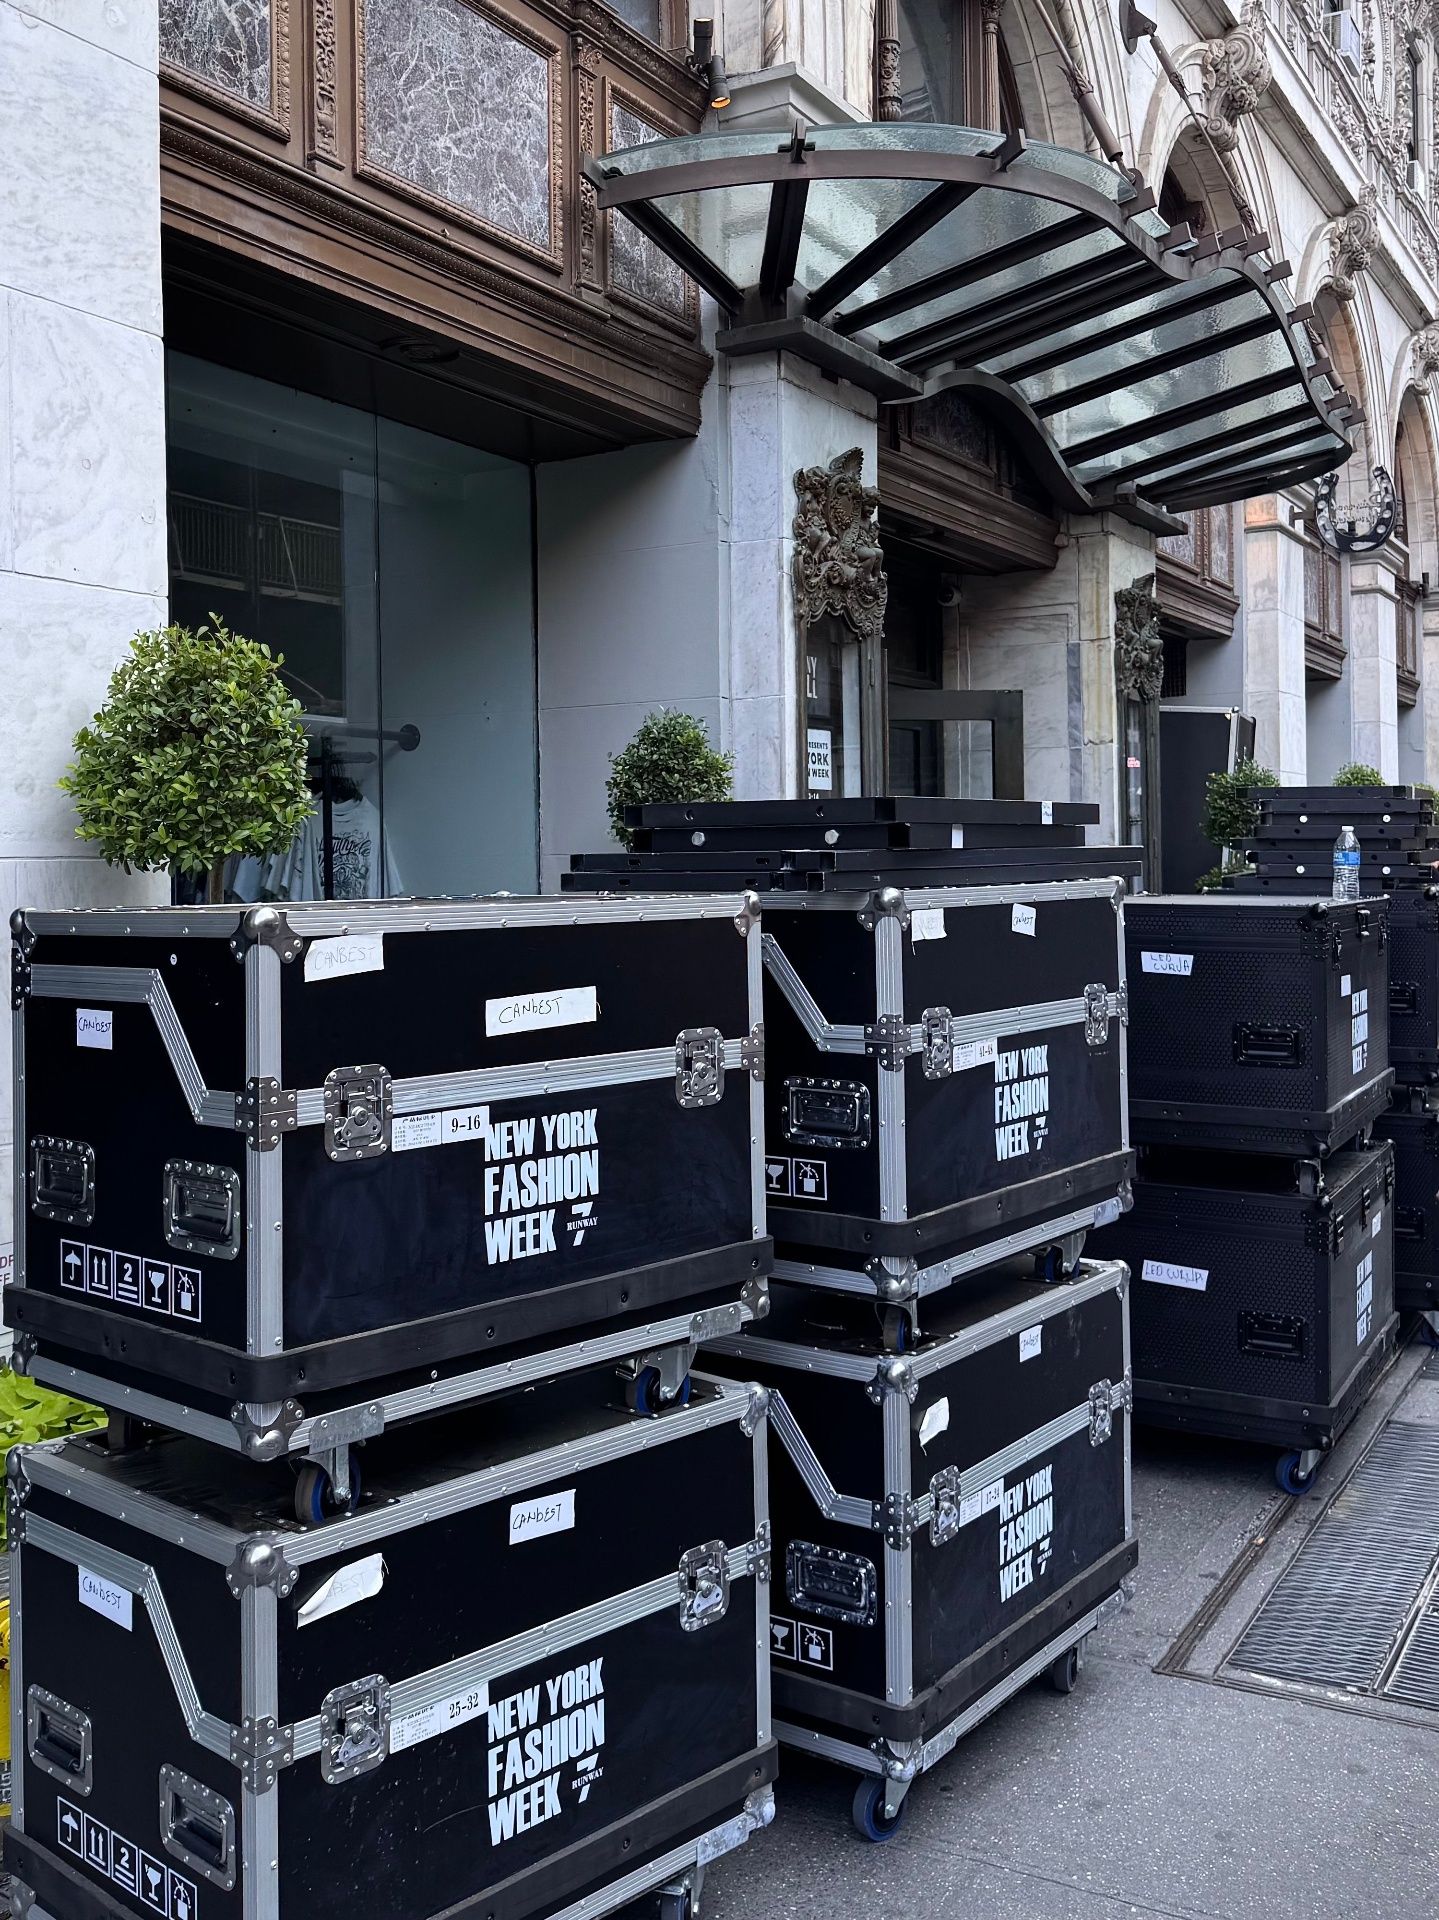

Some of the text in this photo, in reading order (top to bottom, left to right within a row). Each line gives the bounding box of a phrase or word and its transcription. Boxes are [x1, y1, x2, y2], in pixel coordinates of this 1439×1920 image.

[994, 1050, 1020, 1083] NEW
[1020, 1044, 1049, 1077] YORK
[451, 1114, 481, 1133] 9-16
[994, 1075, 1049, 1124] FASHION
[484, 1112, 537, 1162] NEW
[541, 1108, 599, 1152] YORK
[994, 1120, 1030, 1162] WEEK
[484, 1149, 600, 1216] FASHION
[484, 1208, 557, 1266] WEEK
[566, 1216, 599, 1231] RUNWAY
[999, 1481, 1025, 1525] NEW
[1025, 1463, 1053, 1506] YORK
[999, 1495, 1054, 1566] FASHION
[999, 1548, 1034, 1603] WEEK
[449, 1692, 479, 1720] 25-32
[487, 1684, 541, 1744] NEW
[545, 1656, 605, 1716] YORK
[487, 1698, 606, 1799] FASHION
[571, 1766, 604, 1790] RUNWAY
[487, 1770, 562, 1847] WEEK
